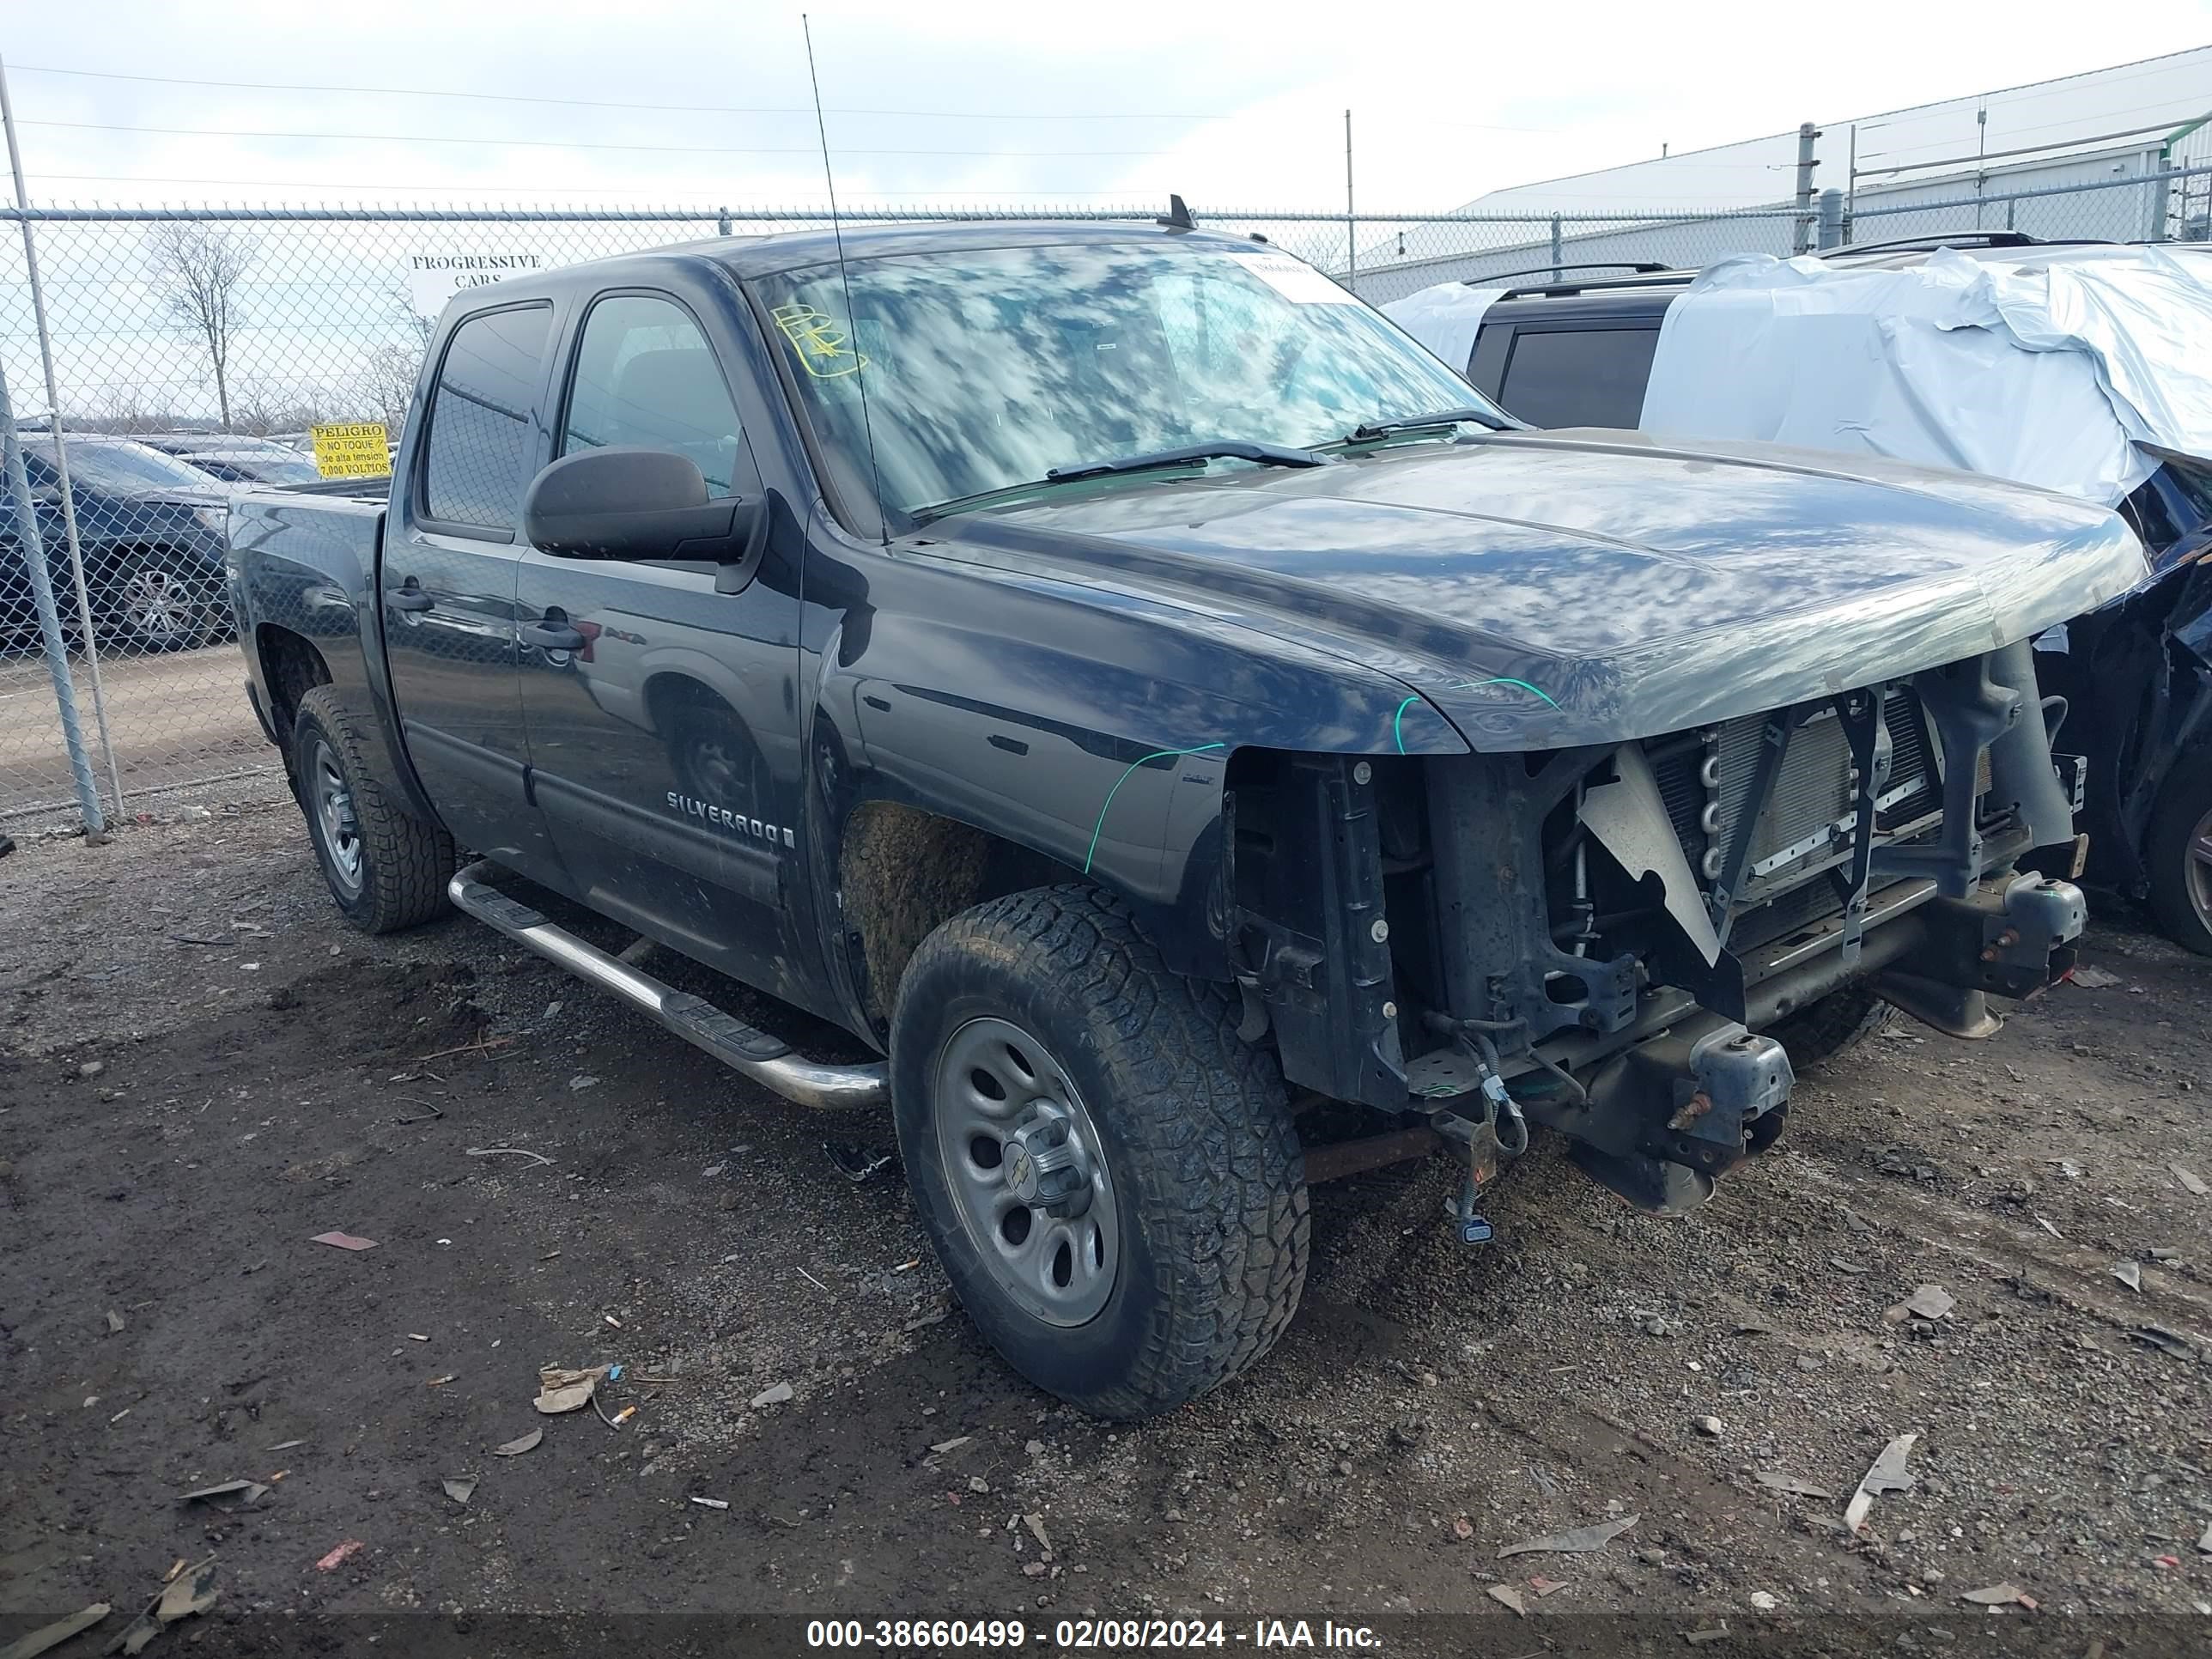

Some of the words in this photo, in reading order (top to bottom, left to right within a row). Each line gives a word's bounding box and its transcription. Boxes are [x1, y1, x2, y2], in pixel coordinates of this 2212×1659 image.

[412, 255, 541, 270] PROGRESSIVE
[315, 426, 382, 437] PELIGRO
[327, 441, 341, 451] NO
[343, 440, 374, 450] TOQUE
[336, 453, 351, 462] alta
[353, 452, 384, 461] tension
[320, 465, 343, 476] 7,000
[345, 463, 388, 474] VOLTIOS
[666, 791, 777, 843] SILVERADO
